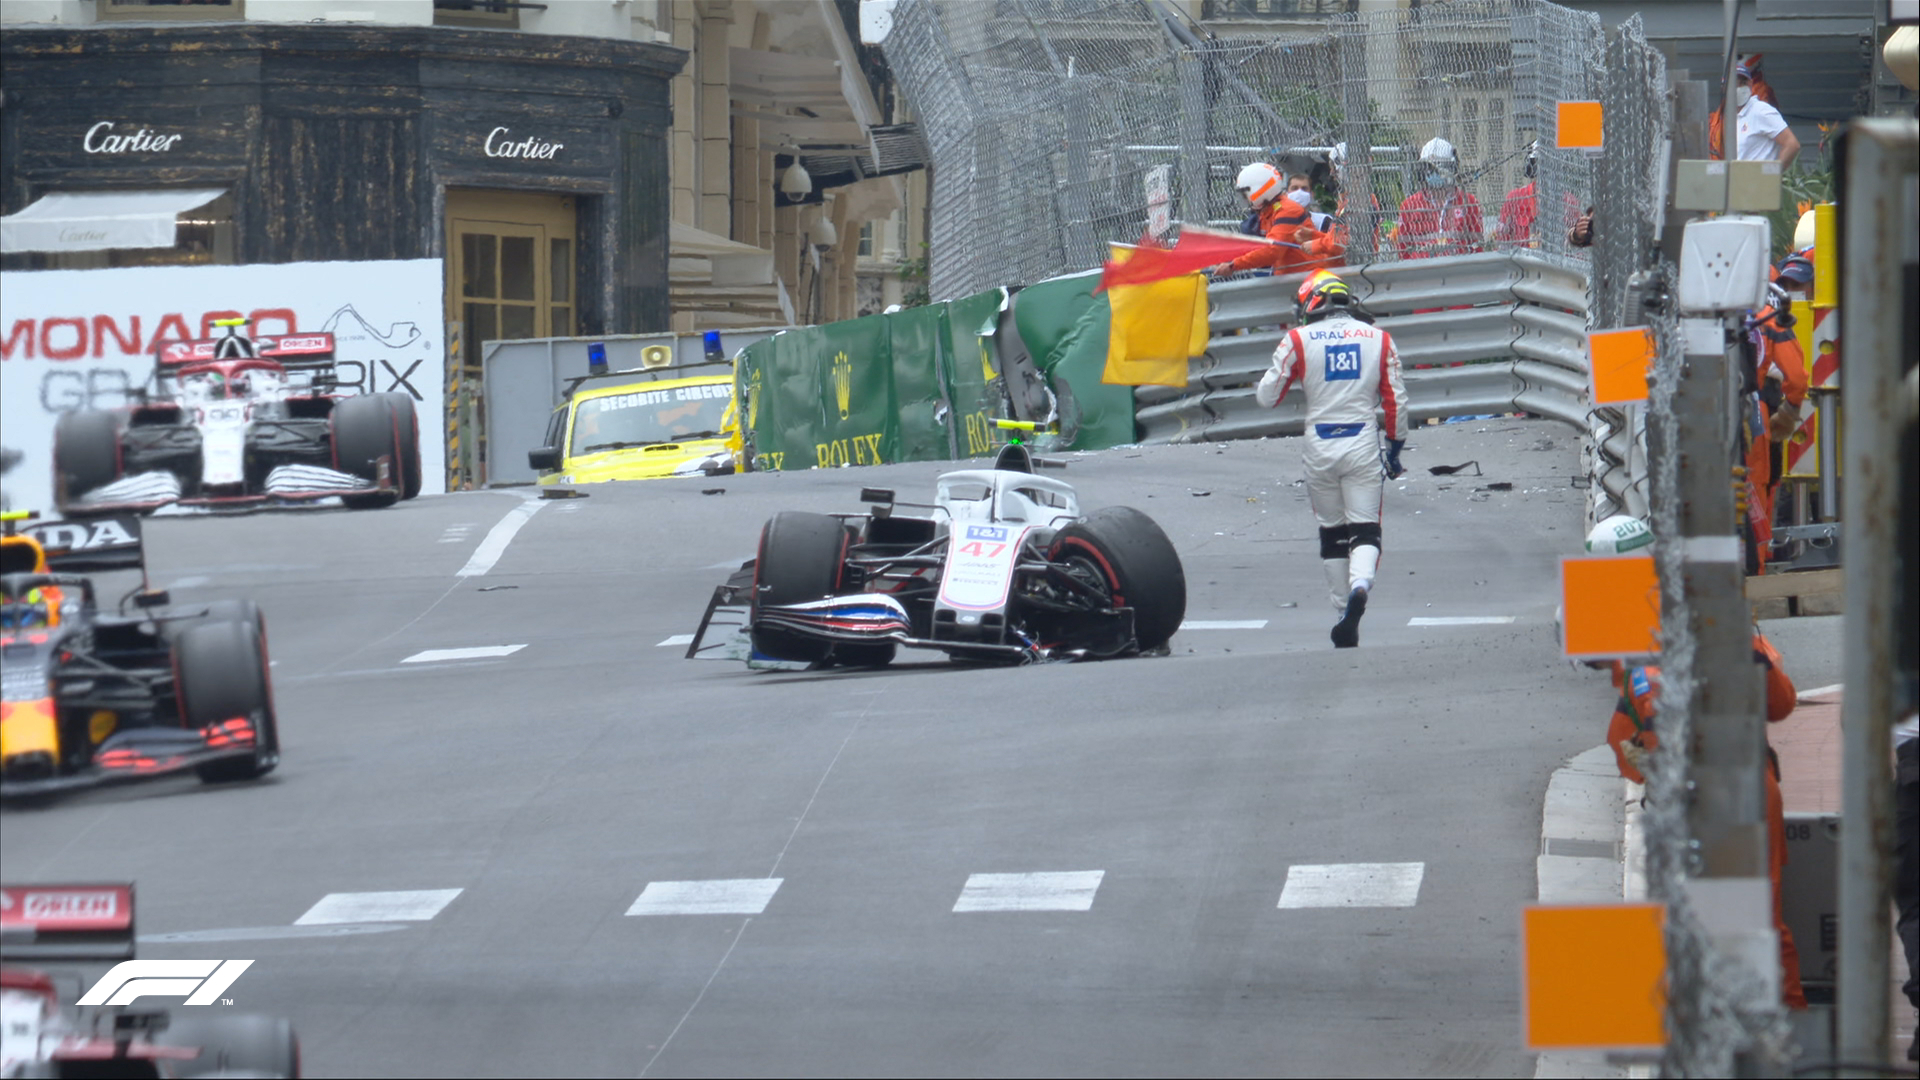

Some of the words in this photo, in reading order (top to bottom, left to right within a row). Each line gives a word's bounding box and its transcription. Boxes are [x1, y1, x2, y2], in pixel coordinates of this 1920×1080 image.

[83, 121, 182, 154] Cartier
[483, 126, 564, 160] Cartier
[1309, 328, 1374, 341] URALKALI
[1327, 350, 1358, 373] 1&1
[1613, 519, 1646, 539] 207
[958, 541, 1008, 558] 47
